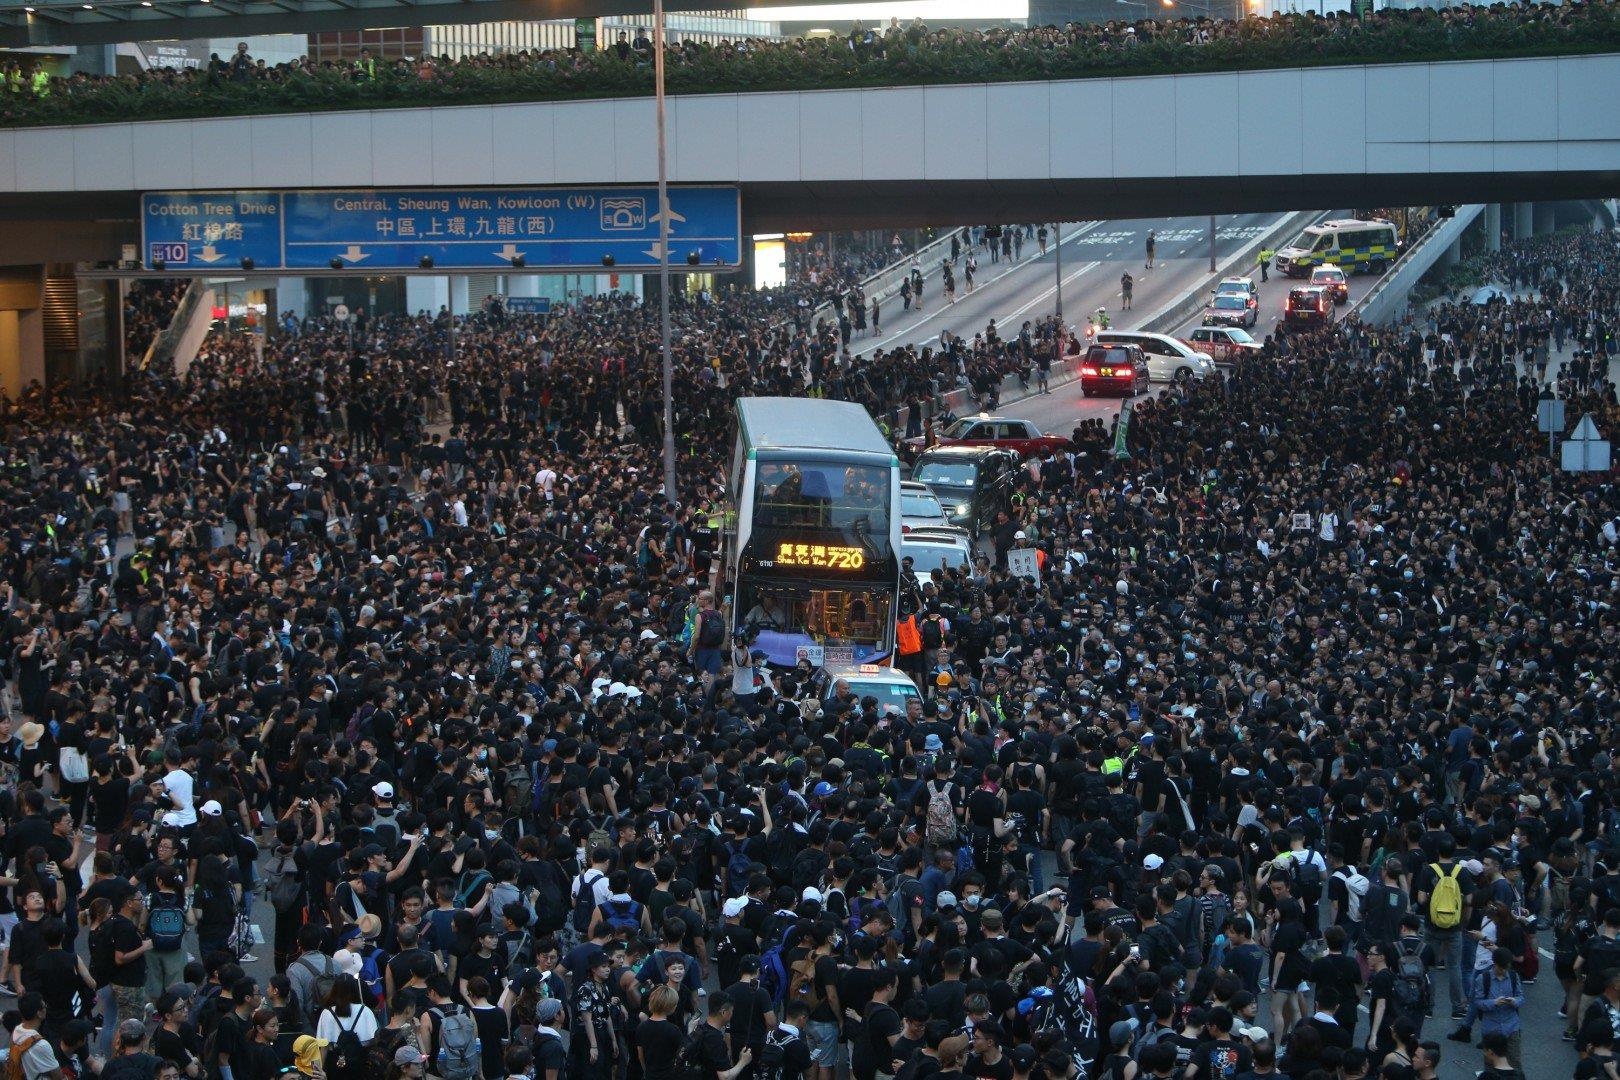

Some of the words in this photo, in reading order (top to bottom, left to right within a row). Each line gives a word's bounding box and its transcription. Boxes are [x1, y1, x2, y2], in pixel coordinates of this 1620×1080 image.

[149, 203, 198, 216] Cotton
[203, 202, 234, 215] Tree
[240, 201, 277, 214] Drive
[398, 197, 450, 211] Sheung
[498, 196, 560, 209] Kowloon
[567, 195, 595, 210] (W)
[632, 215, 643, 224] W
[165, 245, 184, 261] 10
[777, 554, 795, 565] Shau
[827, 551, 863, 569] 720
